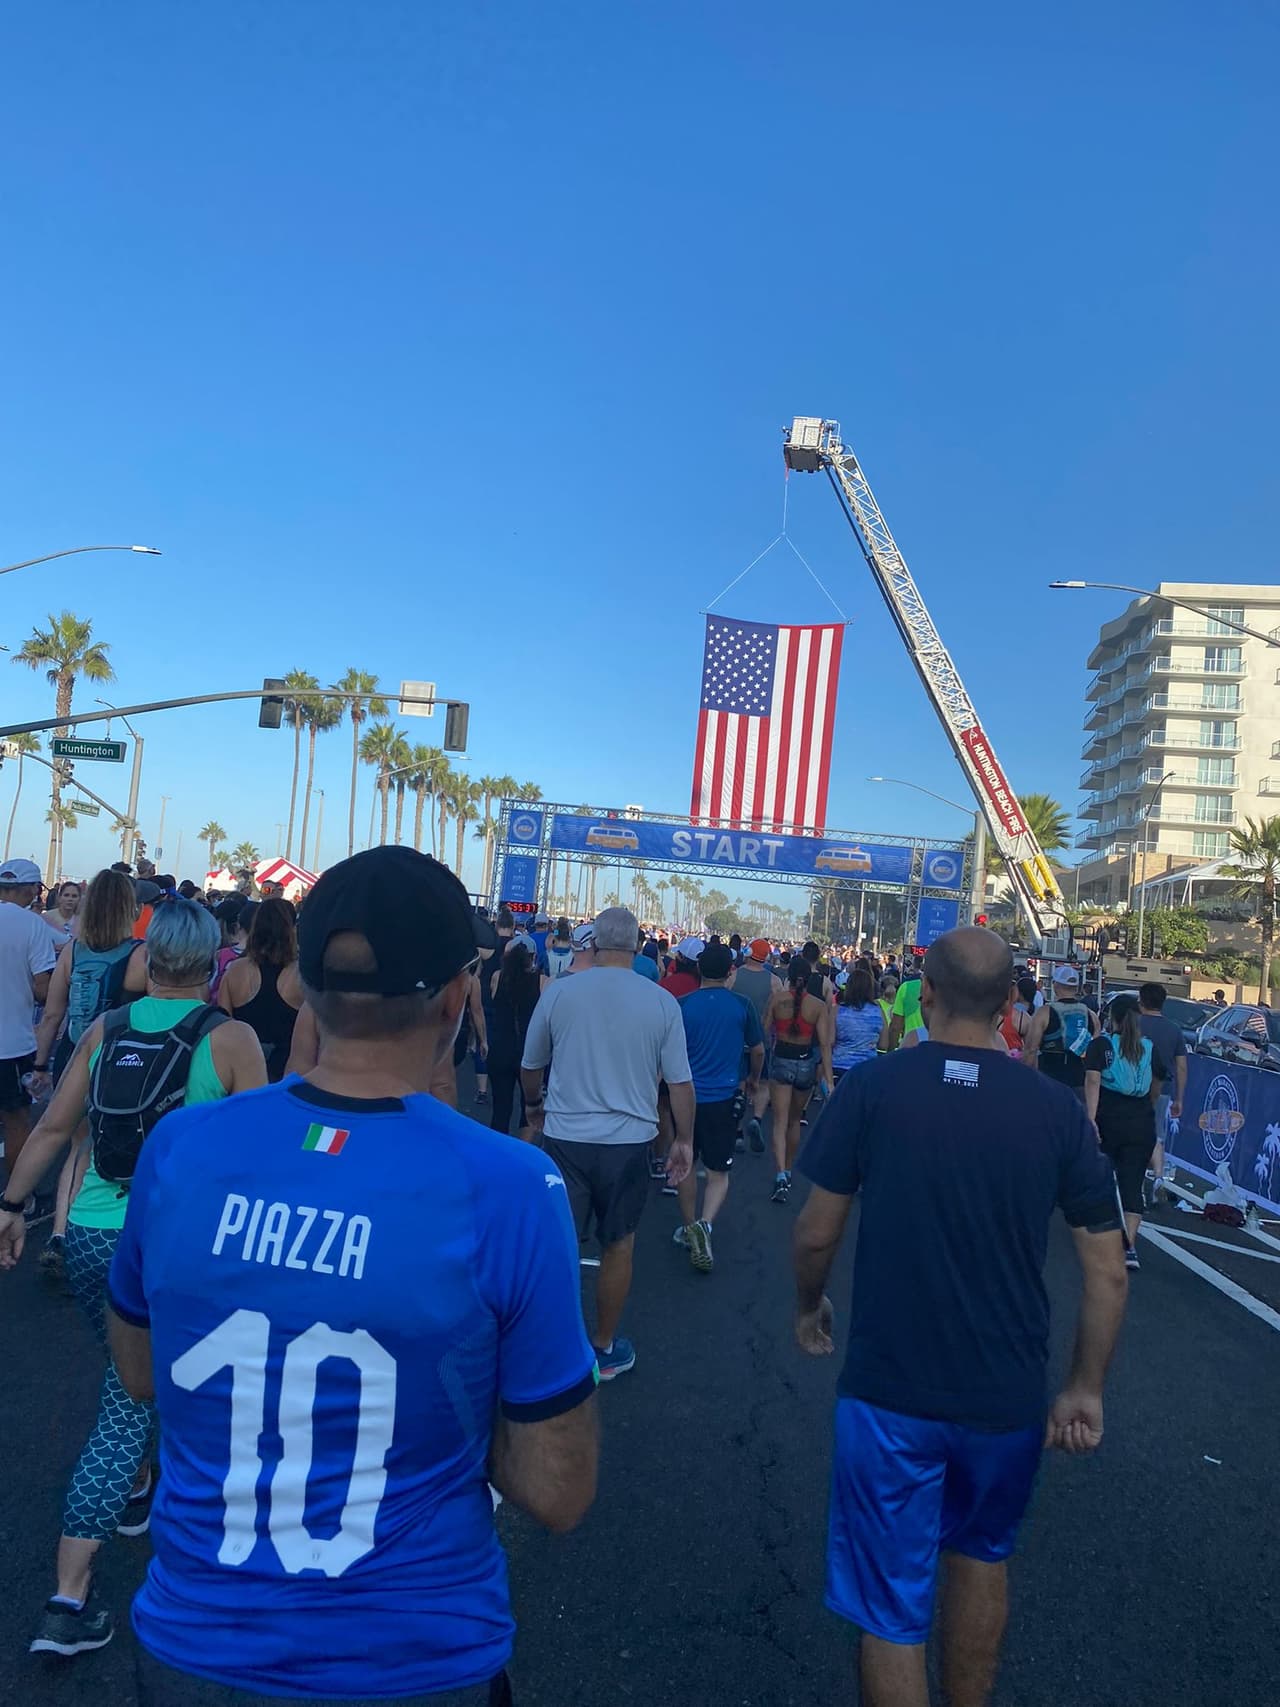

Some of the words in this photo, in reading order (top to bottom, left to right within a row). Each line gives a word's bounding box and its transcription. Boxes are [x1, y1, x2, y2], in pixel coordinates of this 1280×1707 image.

[60, 743, 114, 757] Huntington
[973, 743, 1002, 789] HUNTINGTON
[995, 789, 1014, 816] BEACH
[1007, 816, 1022, 833] FIRE
[670, 830, 785, 866] START
[211, 1193, 372, 1280] PIAZZA
[171, 1308, 397, 1578] 10
